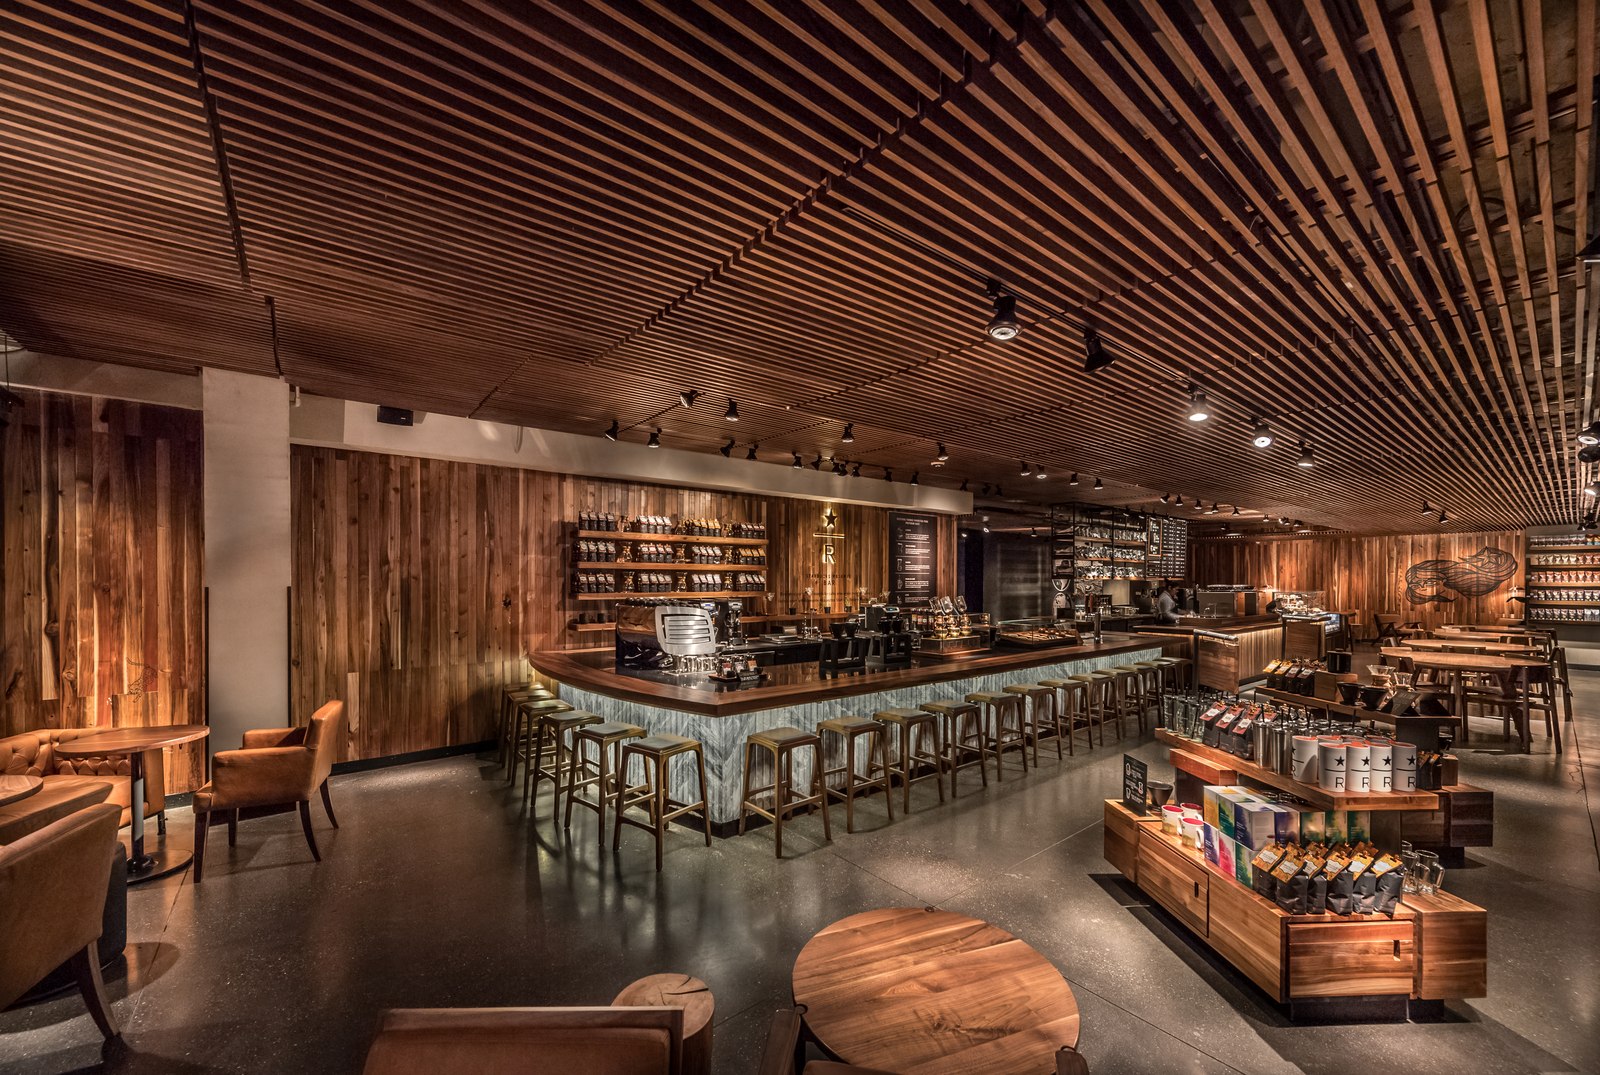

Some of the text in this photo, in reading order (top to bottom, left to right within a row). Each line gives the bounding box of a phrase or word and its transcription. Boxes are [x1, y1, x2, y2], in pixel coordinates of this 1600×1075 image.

[822, 544, 836, 564] R
[1335, 776, 1345, 788] R
[1383, 776, 1392, 788] R
[1407, 776, 1417, 788] R
